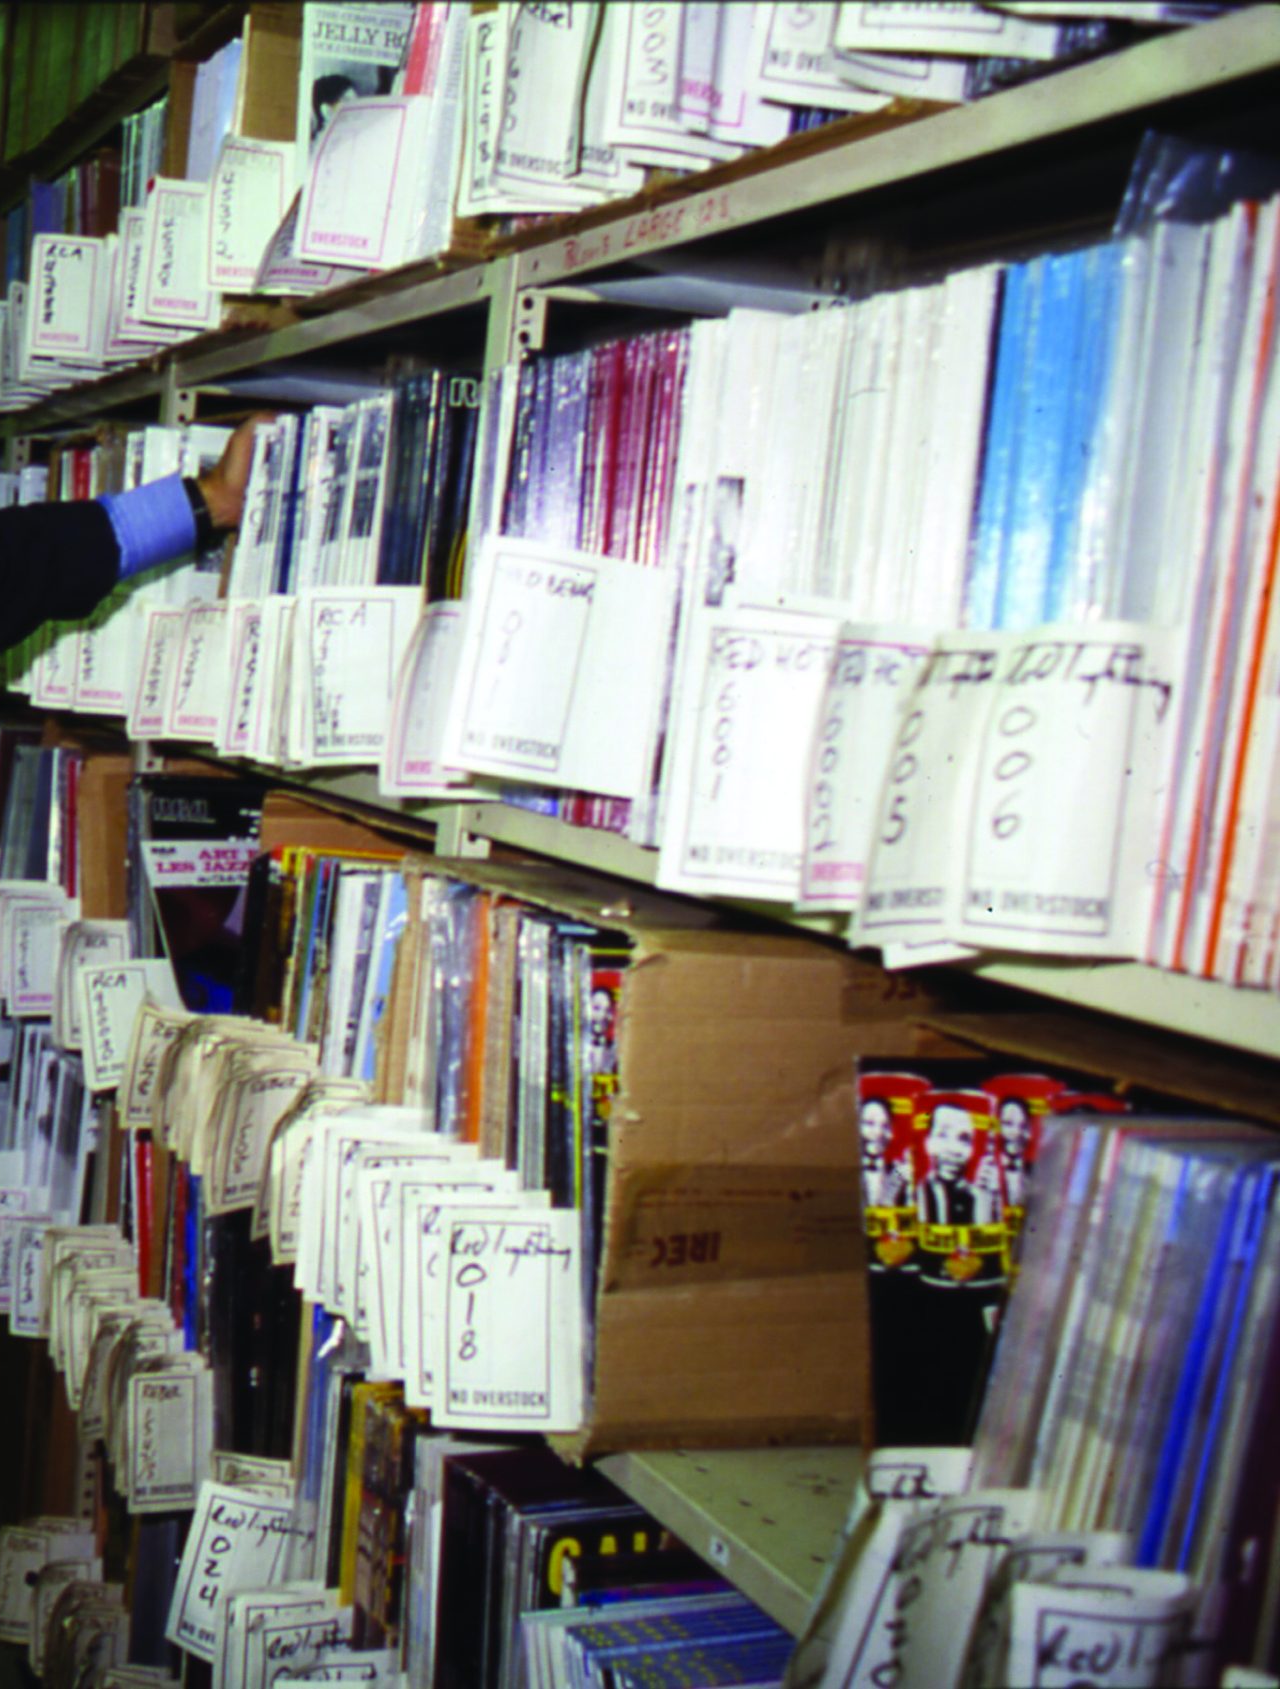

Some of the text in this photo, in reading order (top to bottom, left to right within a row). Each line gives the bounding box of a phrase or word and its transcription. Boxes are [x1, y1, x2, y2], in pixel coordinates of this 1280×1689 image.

[313, 22, 380, 47] JELLY
[449, 1388, 546, 1408] NO OVERSTOCK
